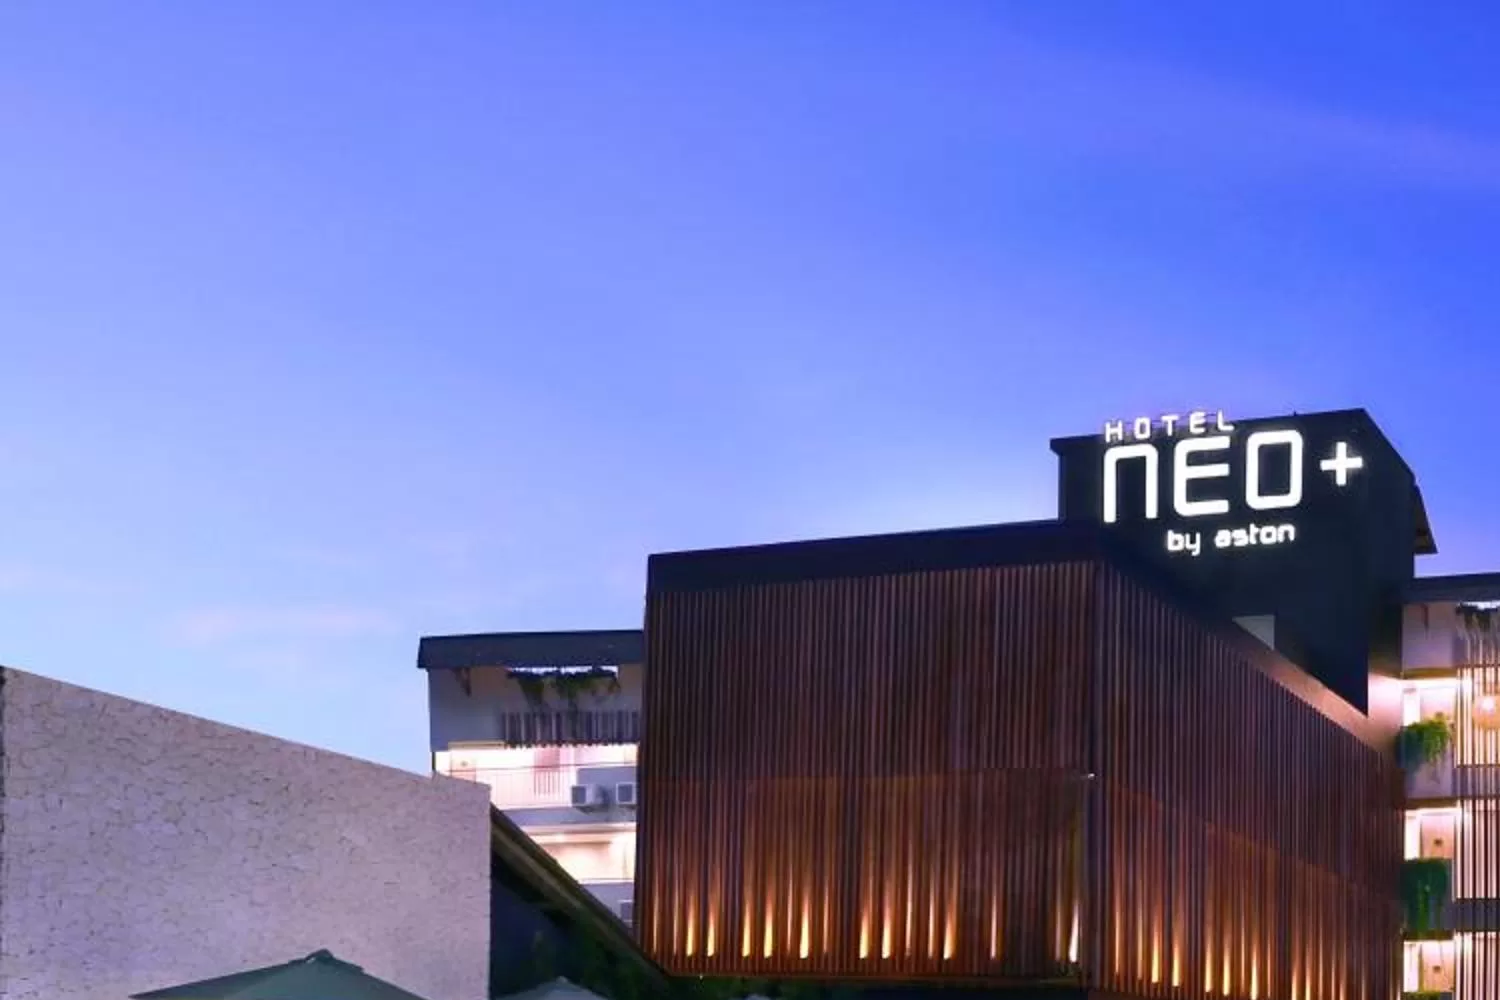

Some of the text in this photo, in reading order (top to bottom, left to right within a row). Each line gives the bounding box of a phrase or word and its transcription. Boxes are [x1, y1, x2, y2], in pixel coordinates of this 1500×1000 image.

[1105, 410, 1235, 443] HOTEL
[1167, 523, 1296, 555] by aston
